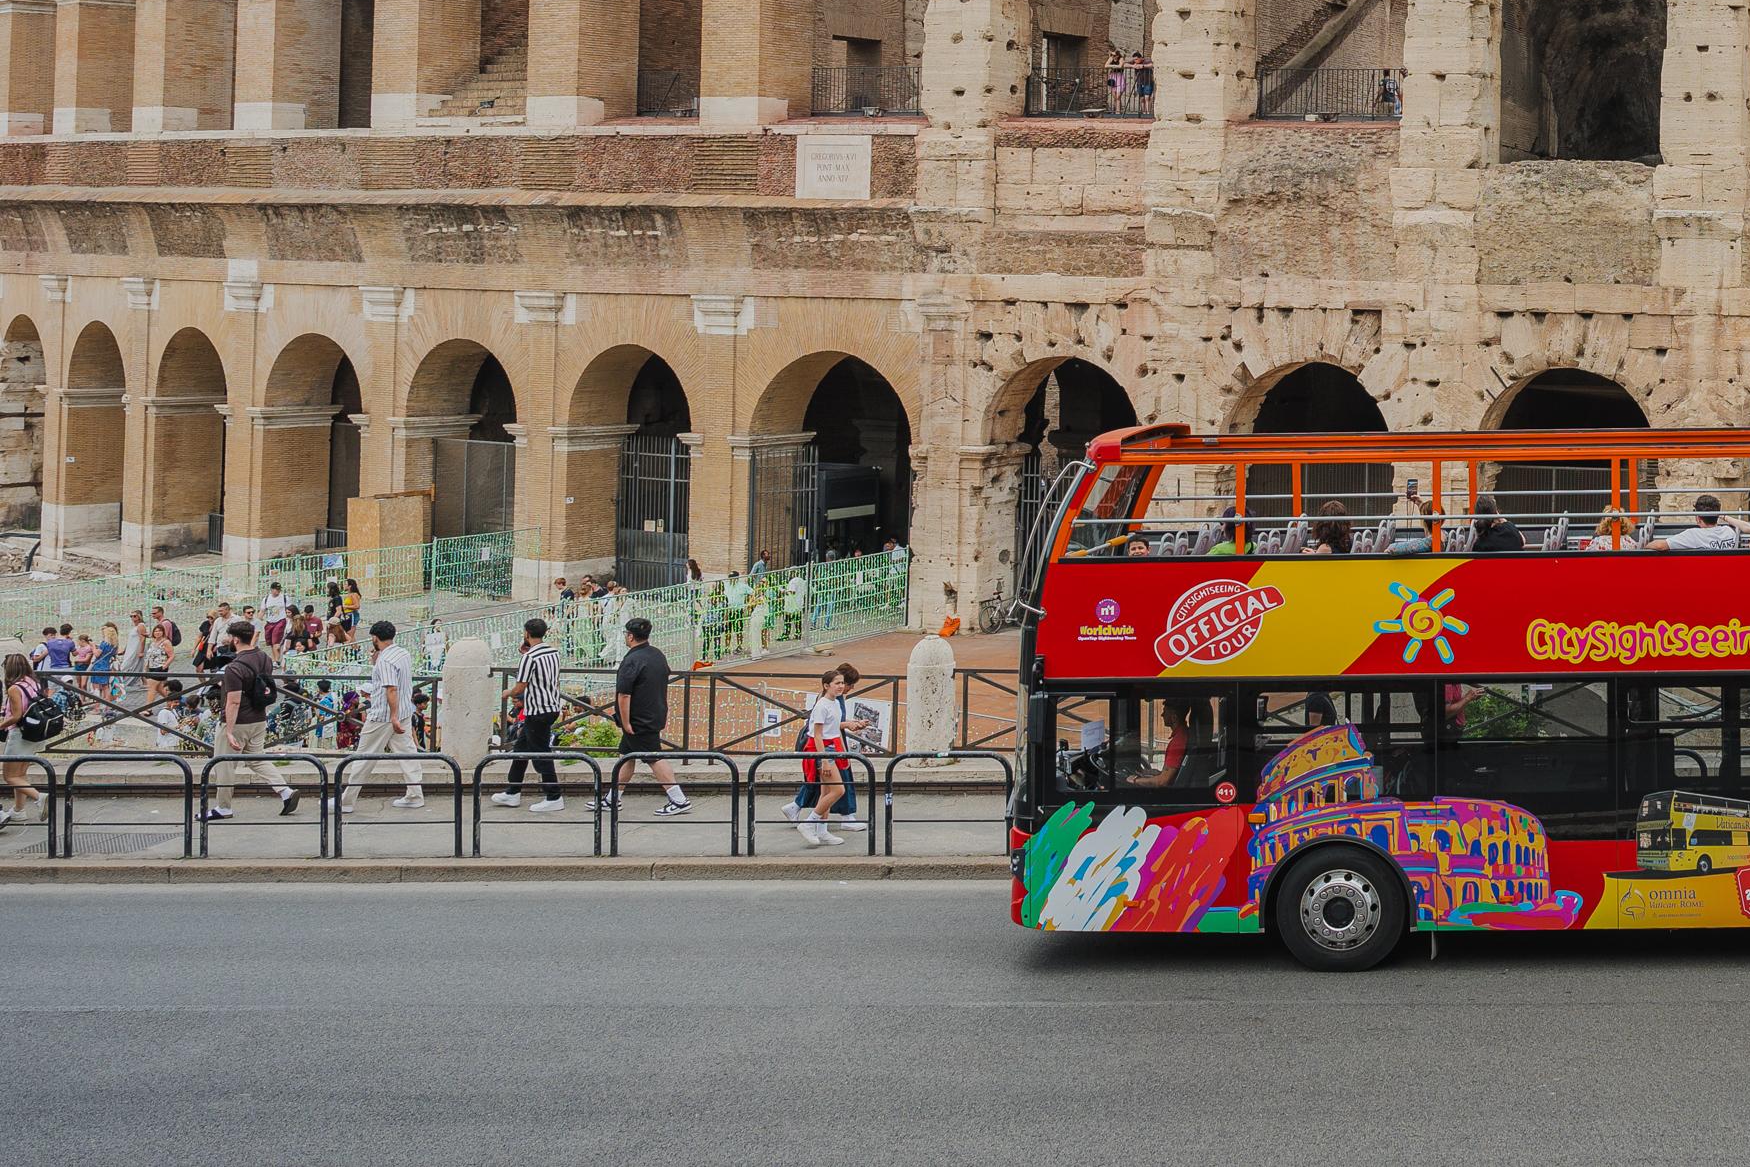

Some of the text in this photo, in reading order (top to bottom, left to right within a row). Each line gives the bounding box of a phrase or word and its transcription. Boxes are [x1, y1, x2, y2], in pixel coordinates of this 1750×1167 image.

[1176, 584, 1241, 621] CITYSIGHTSEEING
[1079, 624, 1135, 636] Worldwide
[1168, 590, 1278, 656] OFFICIAL
[1208, 624, 1257, 658] TOUR
[1218, 788, 1234, 796] 411
[1648, 886, 1697, 900] omnia
